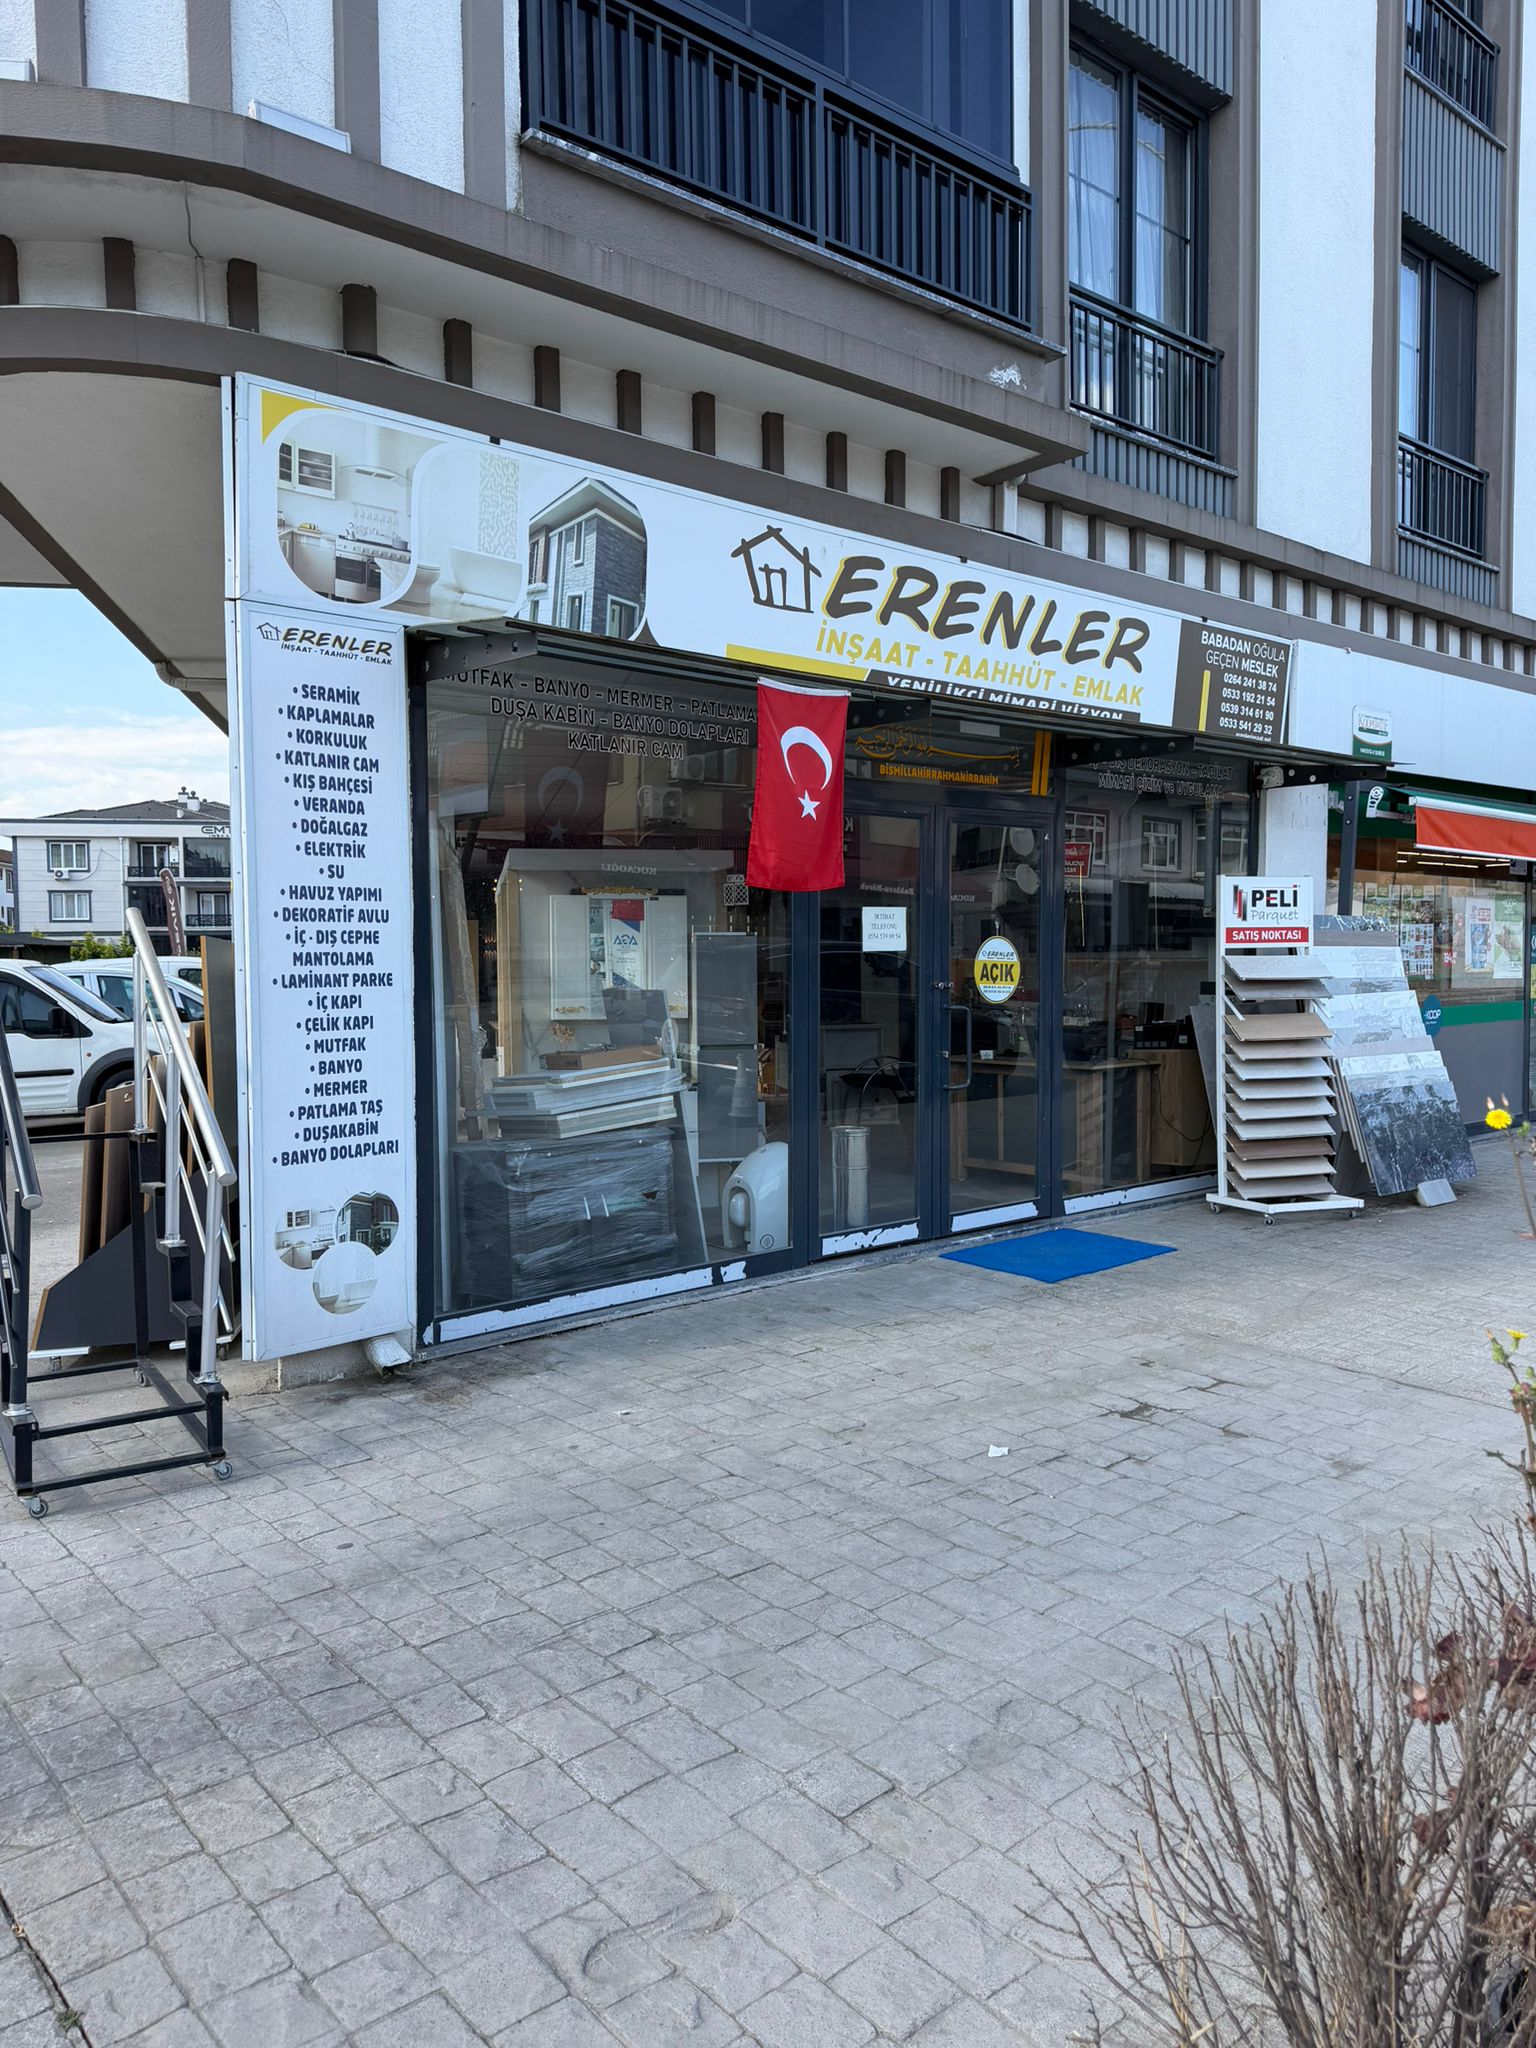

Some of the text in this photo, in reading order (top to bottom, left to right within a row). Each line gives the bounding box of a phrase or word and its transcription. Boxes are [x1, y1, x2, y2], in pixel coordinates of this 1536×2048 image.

[821, 555, 1150, 673] ERENLER
[283, 628, 393, 656] ERENLER
[1201, 630, 1285, 662] BABADAN OĞULA
[281, 643, 393, 665] İNŞAAT TAAHHÜT EMLAK
[816, 619, 1144, 707] İNŞAAT TAAHHÜT EMLAK
[1205, 649, 1279, 678] GEÇEN MESLEK
[1223, 672, 1277, 693] 0264 241 38 74
[301, 684, 360, 706] SERAMİK
[534, 677, 590, 699] BANYO
[607, 688, 673, 713] MERMER
[690, 699, 757, 723] PATLAMA
[1222, 687, 1276, 707] 0533 192 21 54
[287, 704, 375, 729] KAPLAMALAR
[490, 696, 749, 745] DUŞA KABİN BANYO DOLAPLARI
[1221, 702, 1274, 721] 0539 314 61 90
[1219, 717, 1273, 735] 0533 541 29 32
[296, 728, 367, 750] KORKULUK
[567, 731, 684, 760] KATLANIR CAM
[284, 750, 380, 773] KATLANIR CAM
[1198, 762, 1233, 780] TADİLAT
[293, 773, 373, 796] KIŞ BAHÇESİ
[1098, 770, 1225, 799] MİMARİ ÇİZİM ve UYGULAMA
[302, 796, 365, 815] VERANDA
[300, 816, 368, 837] DOĞALGAZ
[304, 840, 366, 859] ELEKTRİK
[327, 864, 345, 879] SU
[289, 885, 382, 902] HAVUZ YAPIMI
[1251, 885, 1298, 908] PELİ
[282, 905, 389, 923] DEKORATİF AVLU
[1251, 909, 1299, 925] Parquet
[294, 925, 380, 948] İÇ DIŞ CEPHE
[1232, 930, 1301, 941] SATIŞ NOKTASI
[292, 952, 374, 967] MANTOLAMA
[281, 970, 393, 989] LAMİNANT PARKE
[980, 962, 1015, 984] AÇIK
[316, 992, 362, 1013] İÇ KAPI
[305, 1013, 374, 1035] ÇELİK KAPI
[314, 1037, 366, 1054] MUTFAK
[318, 1059, 363, 1075] BANYO
[313, 1080, 368, 1097] MERMER
[298, 1099, 383, 1120] PATLAMA TAŞ
[303, 1118, 379, 1143] DUŞAKABİN
[281, 1139, 399, 1167] BANYO DOLAPLARI
